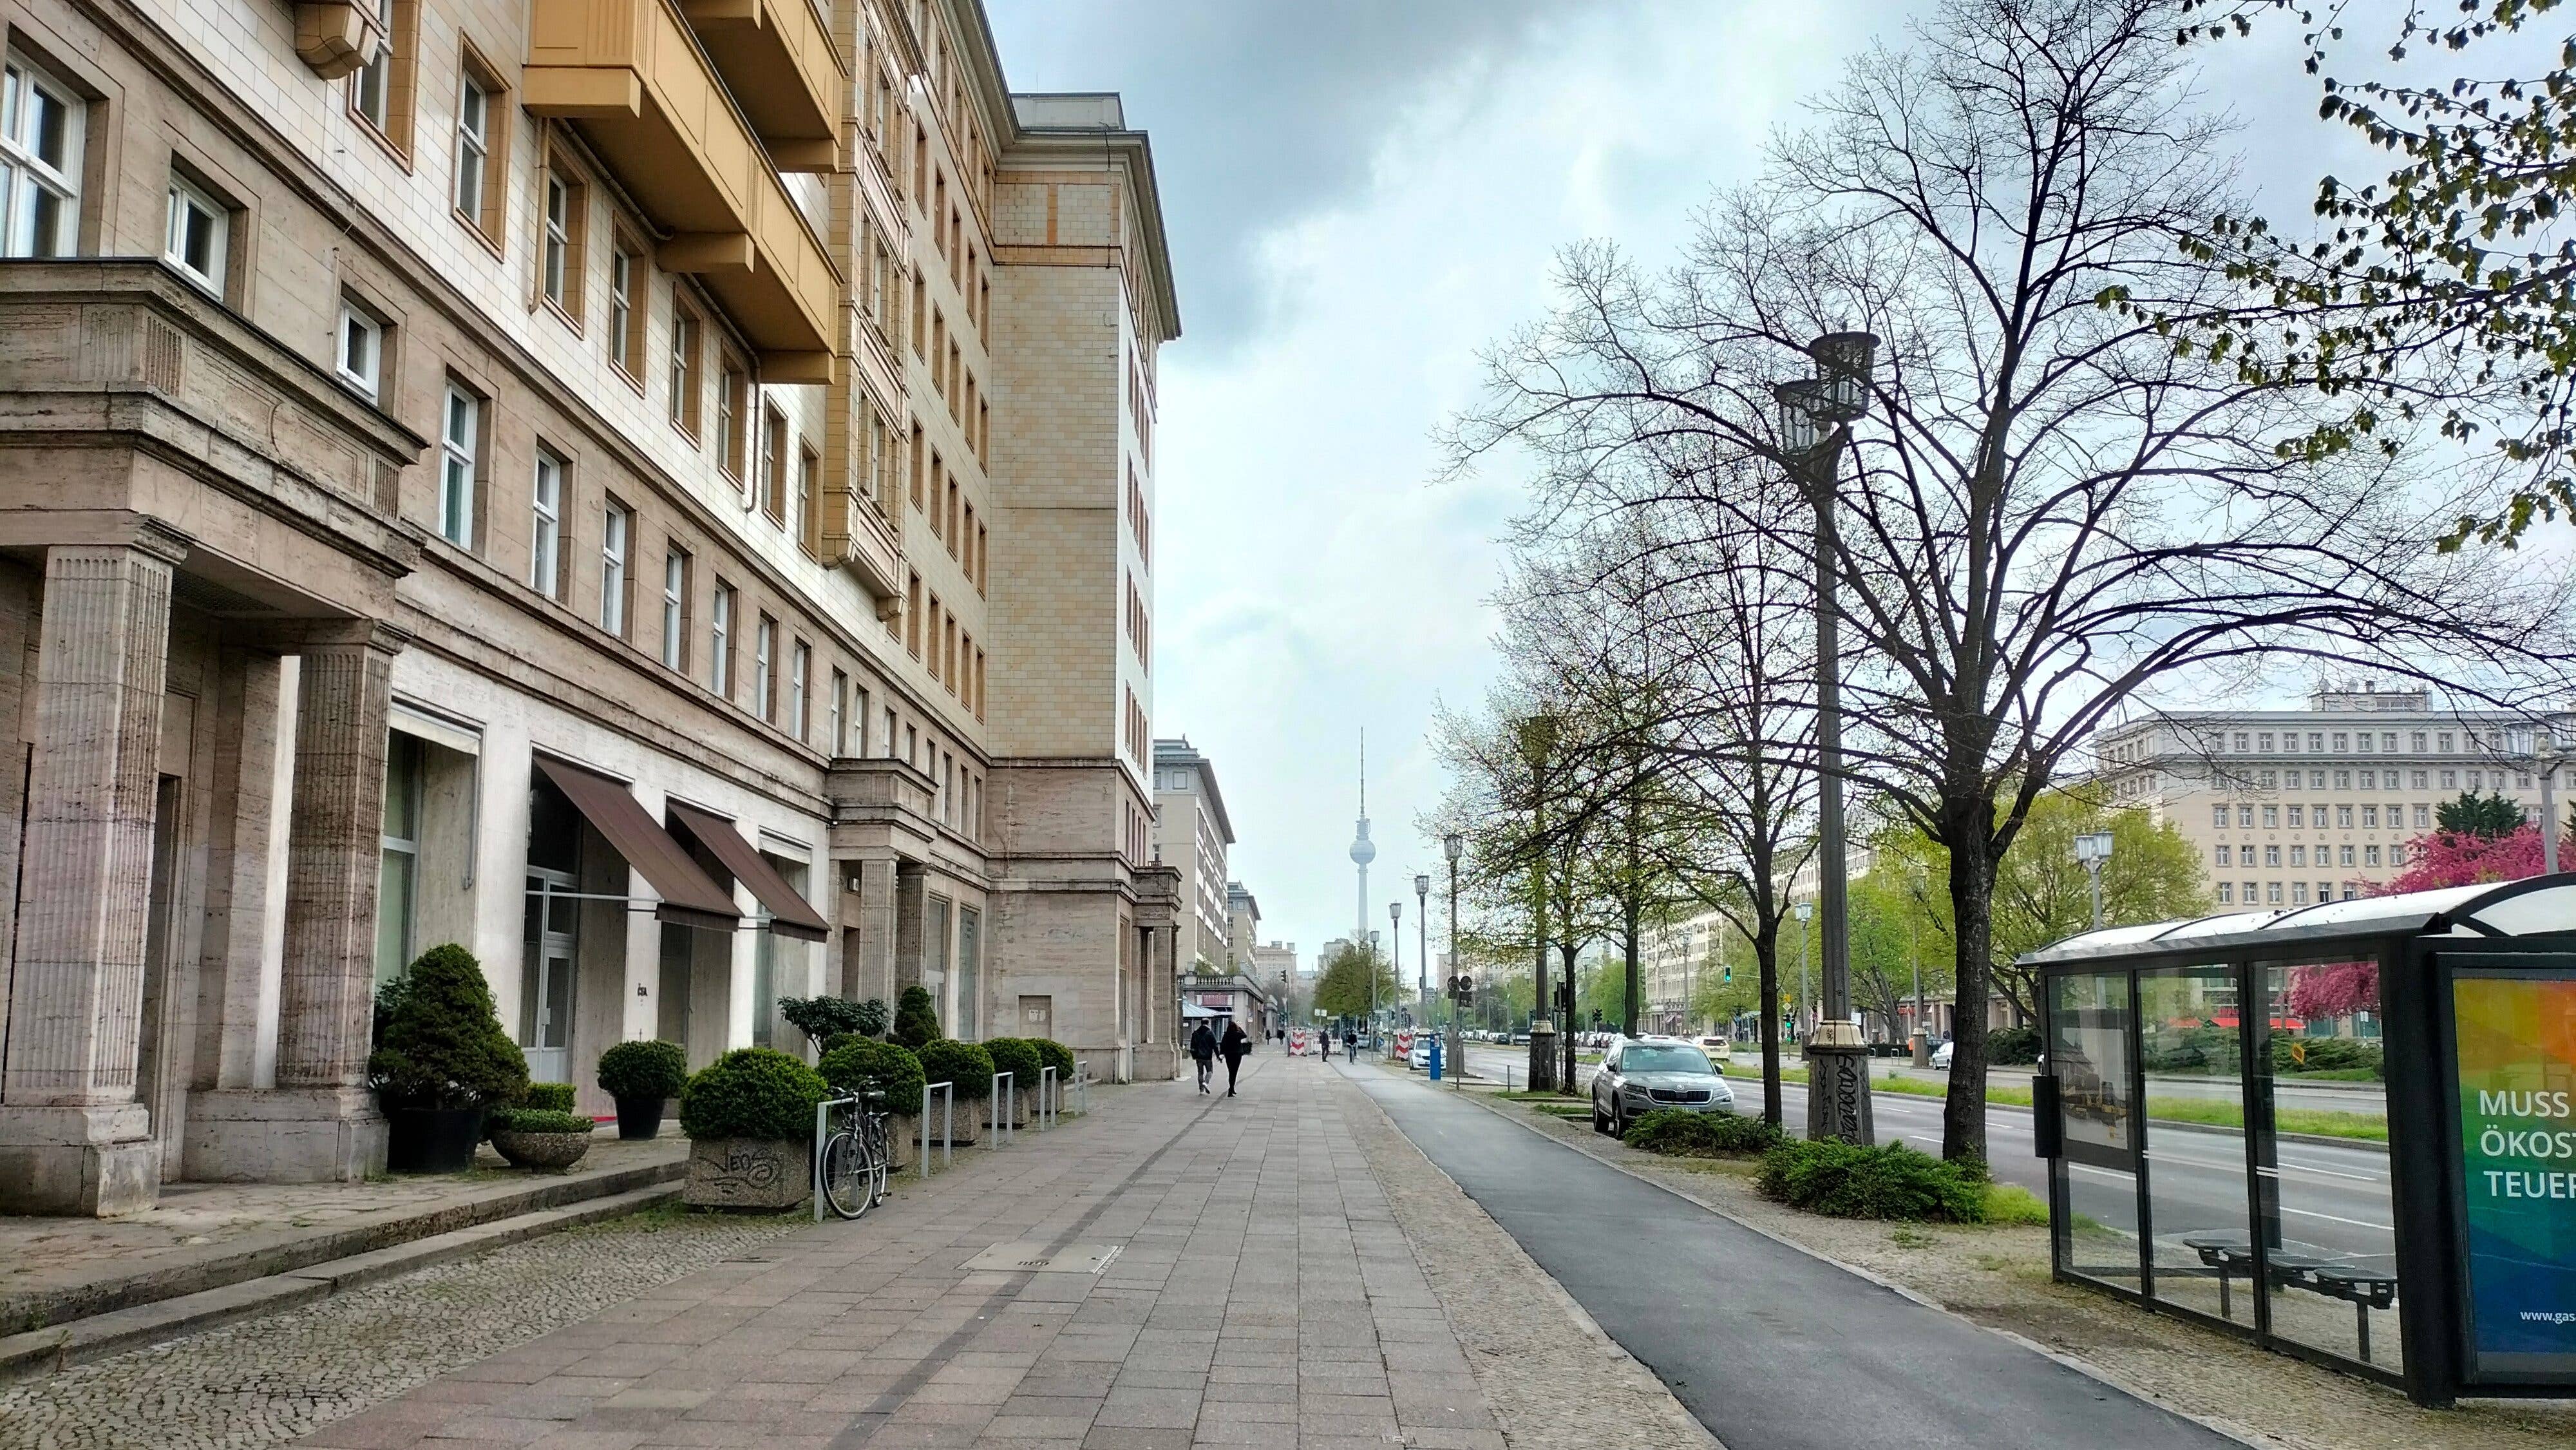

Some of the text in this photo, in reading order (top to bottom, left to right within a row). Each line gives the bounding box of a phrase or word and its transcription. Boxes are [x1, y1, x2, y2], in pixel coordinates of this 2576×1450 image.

[2480, 1090, 2570, 1118] MUSS
[2481, 1124, 2576, 1158] ÖKOS
[2520, 1312, 2576, 1324] www.gas
